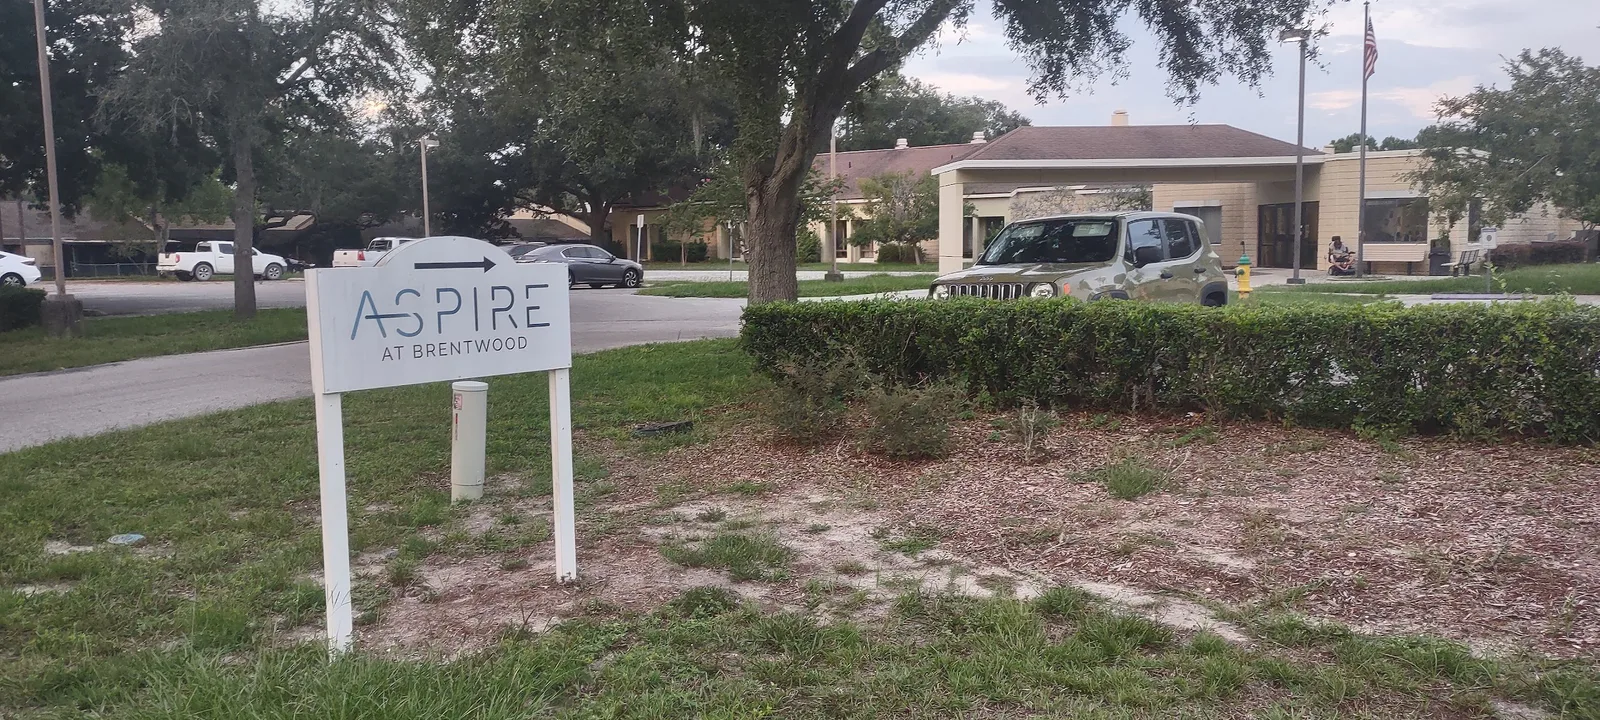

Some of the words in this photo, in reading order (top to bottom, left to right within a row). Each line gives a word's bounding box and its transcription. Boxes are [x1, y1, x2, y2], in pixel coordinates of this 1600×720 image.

[351, 283, 551, 341] ASPIRE
[381, 345, 405, 362] AT
[413, 336, 528, 359] BRENTWOOD
